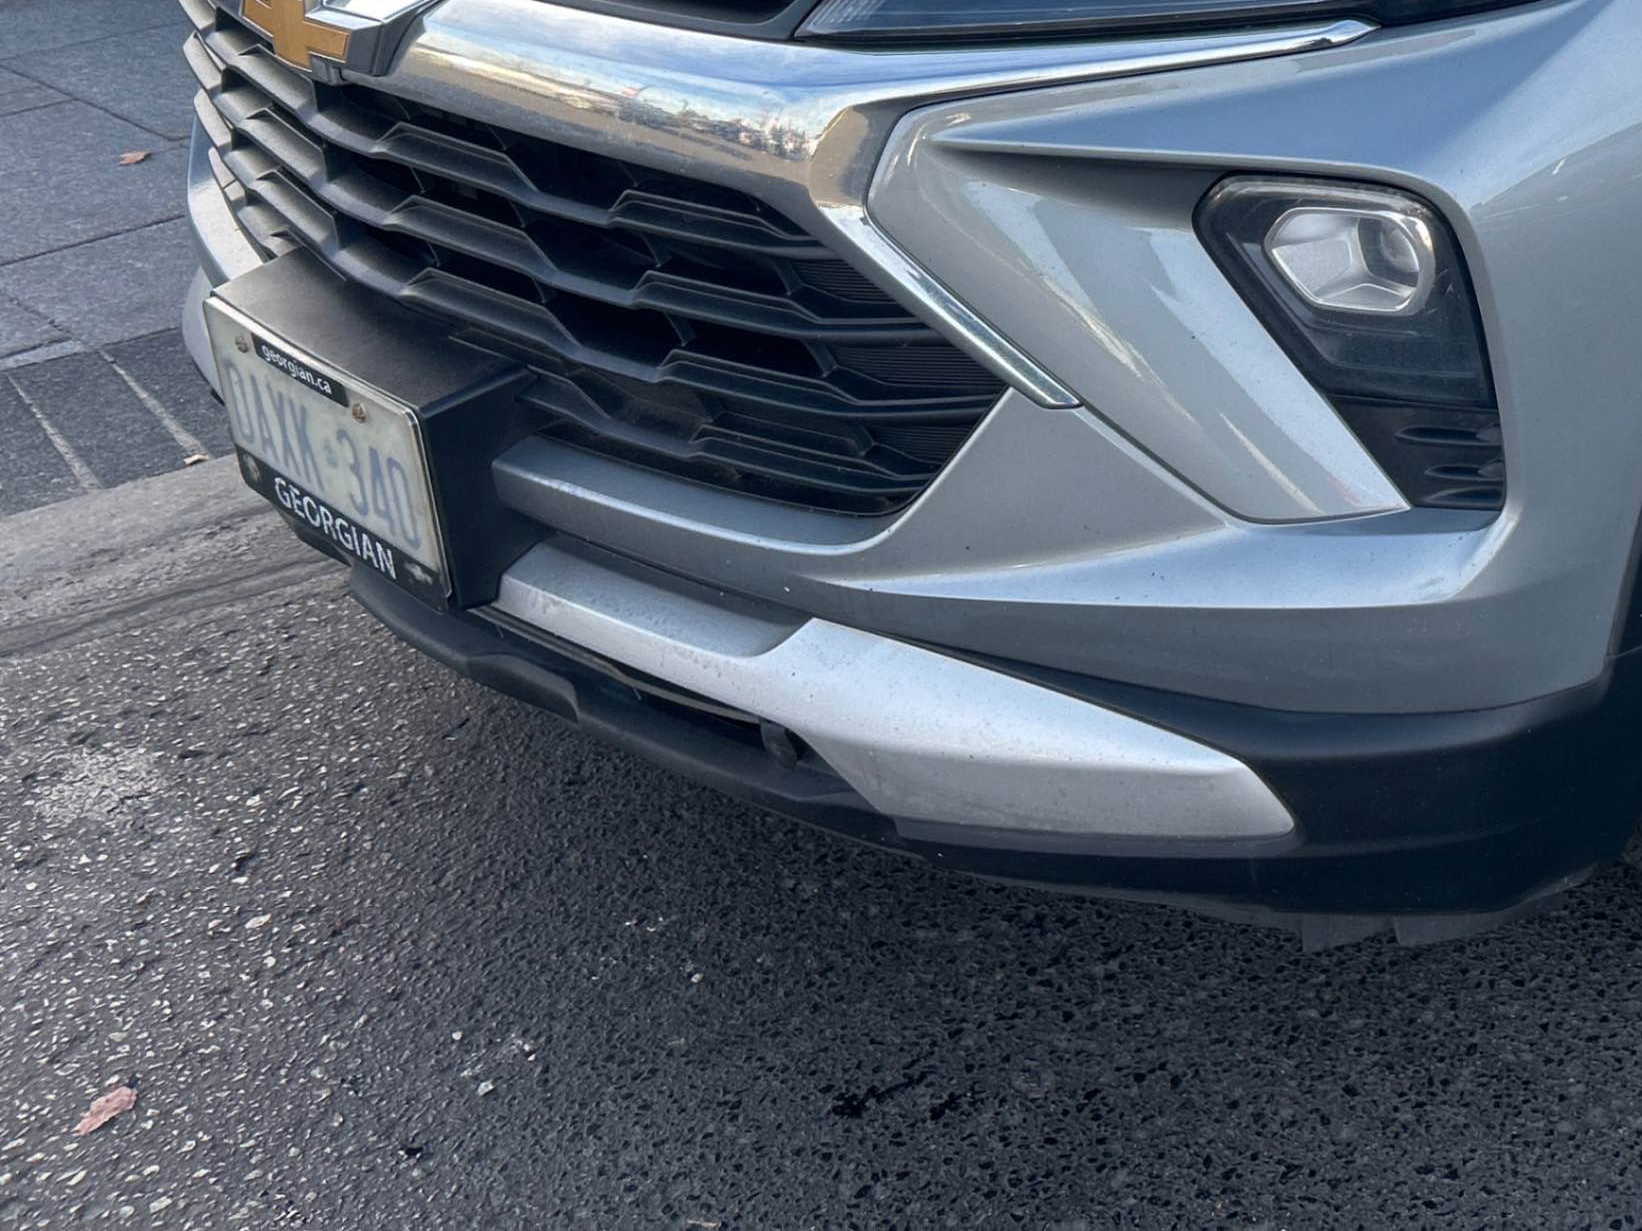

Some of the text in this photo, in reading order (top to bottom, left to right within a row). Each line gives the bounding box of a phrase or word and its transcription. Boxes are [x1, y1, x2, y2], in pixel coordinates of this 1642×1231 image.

[261, 343, 333, 396] georgian.ca
[274, 475, 398, 581] GEORGIAN
[337, 428, 422, 550] 340
